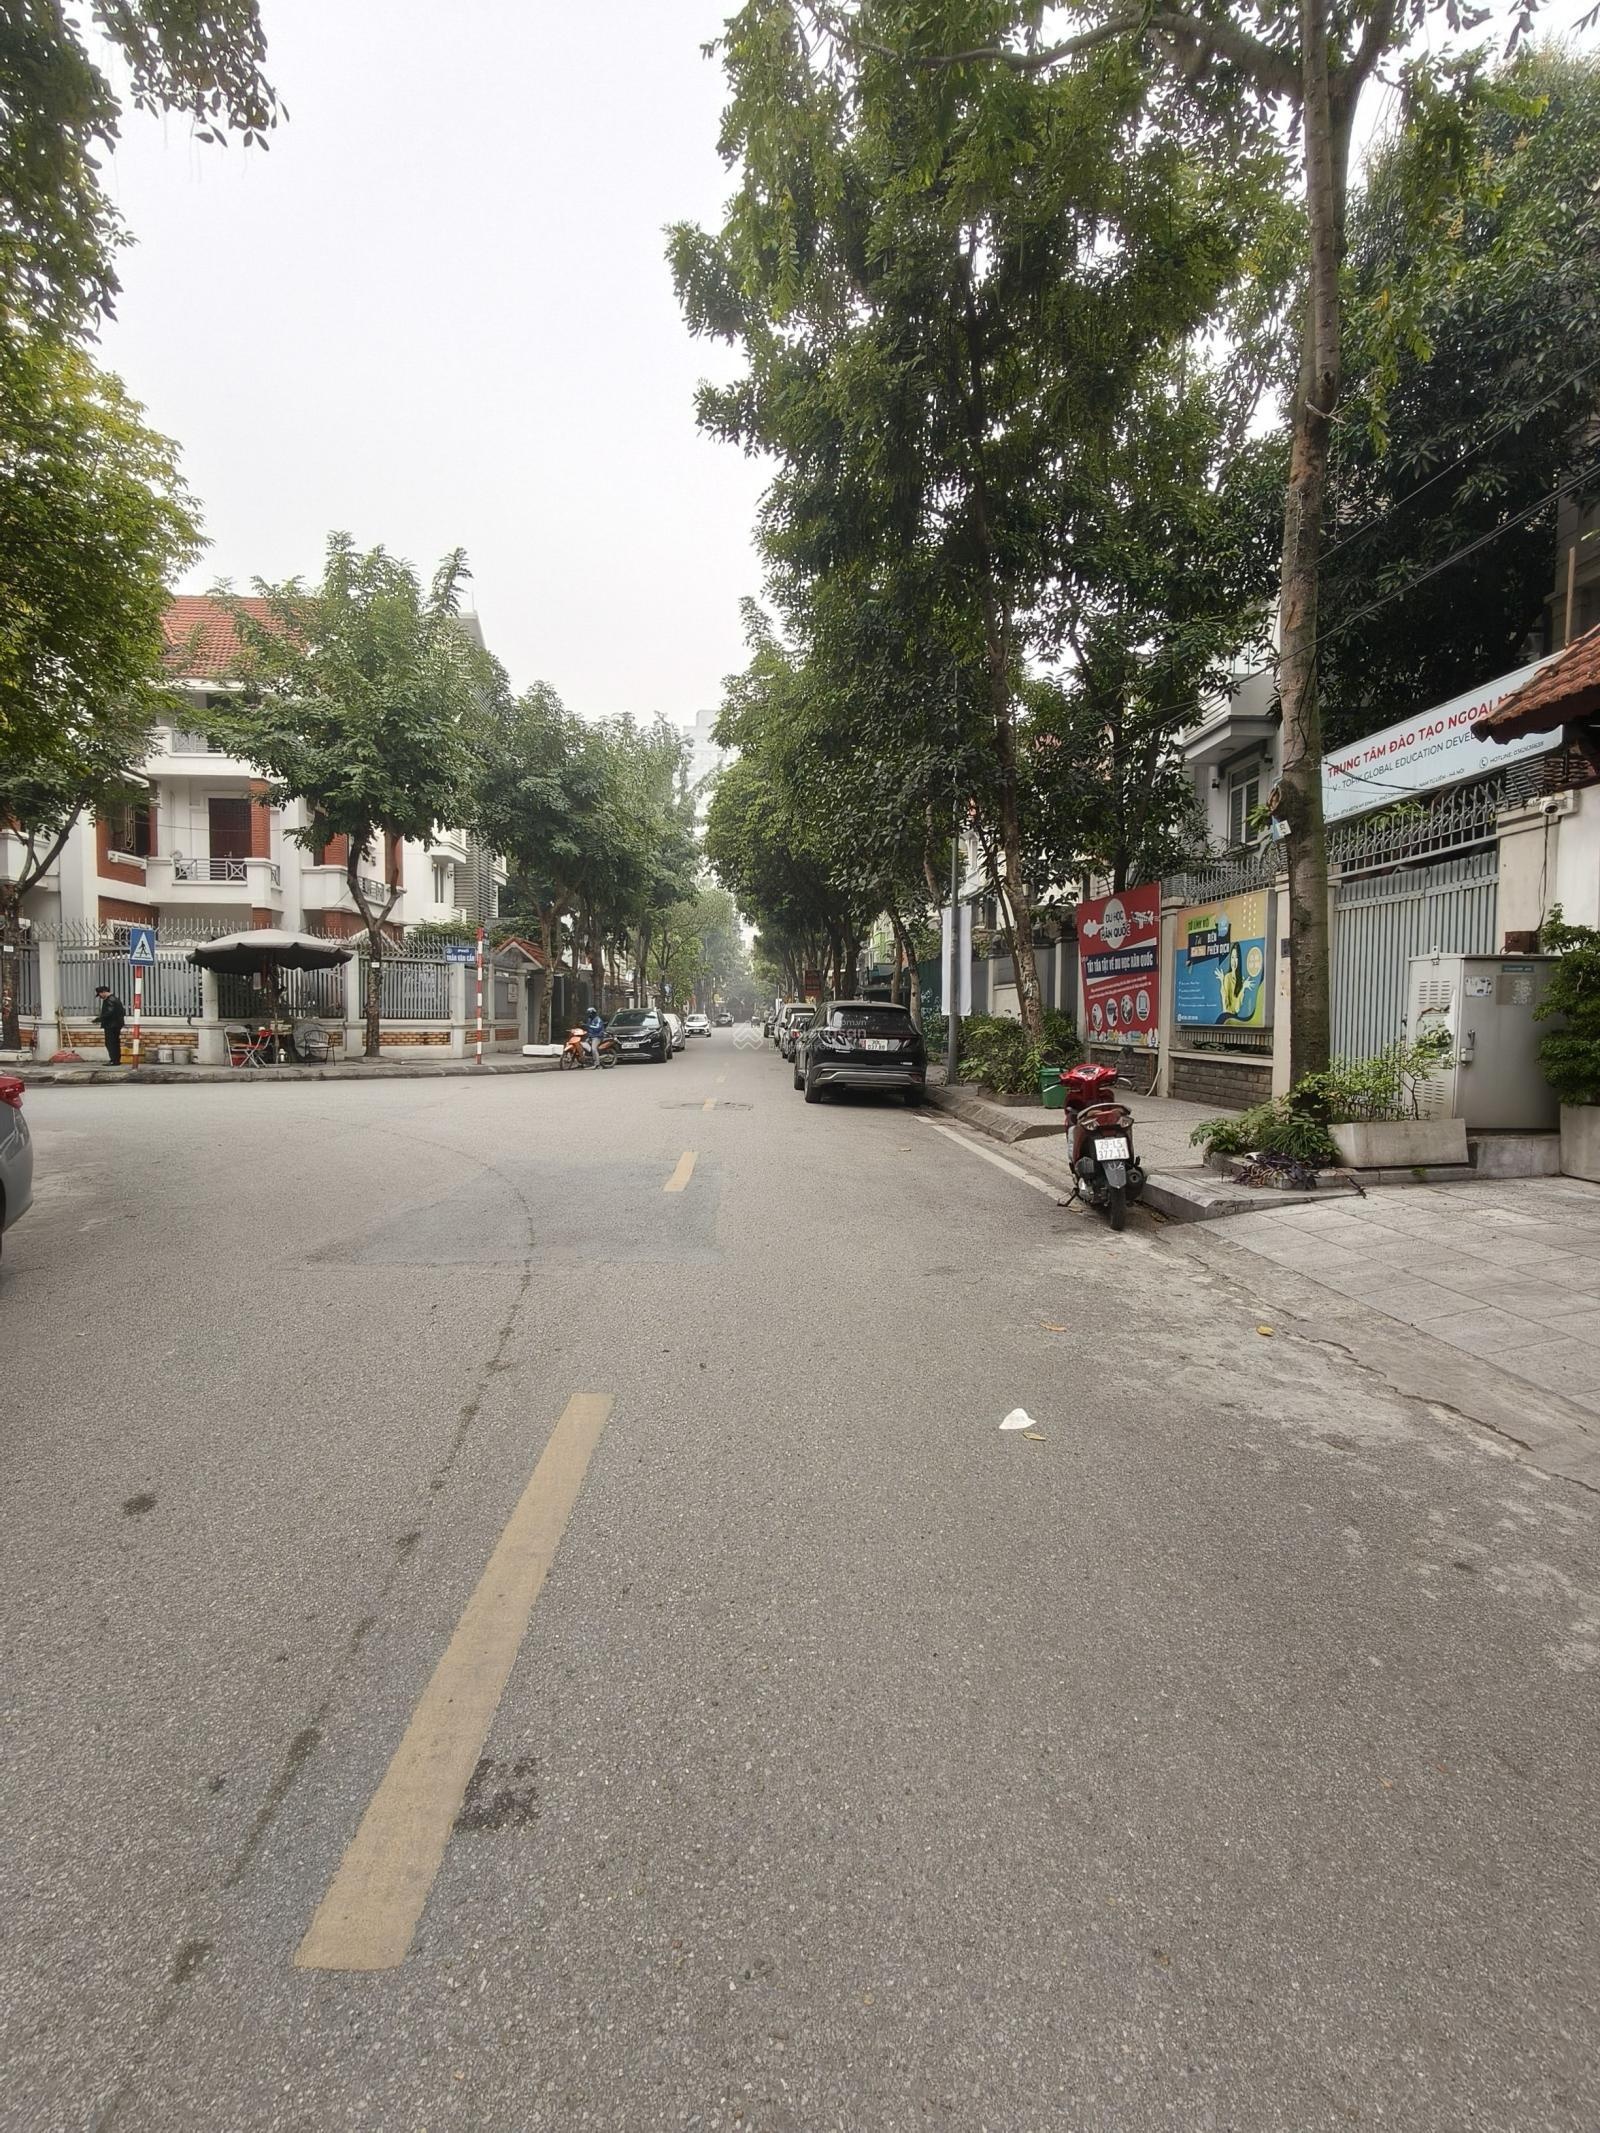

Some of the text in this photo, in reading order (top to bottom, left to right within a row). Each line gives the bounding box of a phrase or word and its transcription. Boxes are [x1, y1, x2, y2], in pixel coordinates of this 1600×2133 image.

[1327, 755, 1361, 778] TRUNG
[1363, 744, 1386, 764] TÂM
[1389, 733, 1415, 753] ĐÀO
[1418, 720, 1444, 742] TẠO
[1364, 763, 1394, 780] GLOBAL
[1395, 741, 1443, 768] EDUCATION
[1105, 910, 1123, 923] DU HỌC
[1101, 923, 1130, 939] HÀN QUỐC
